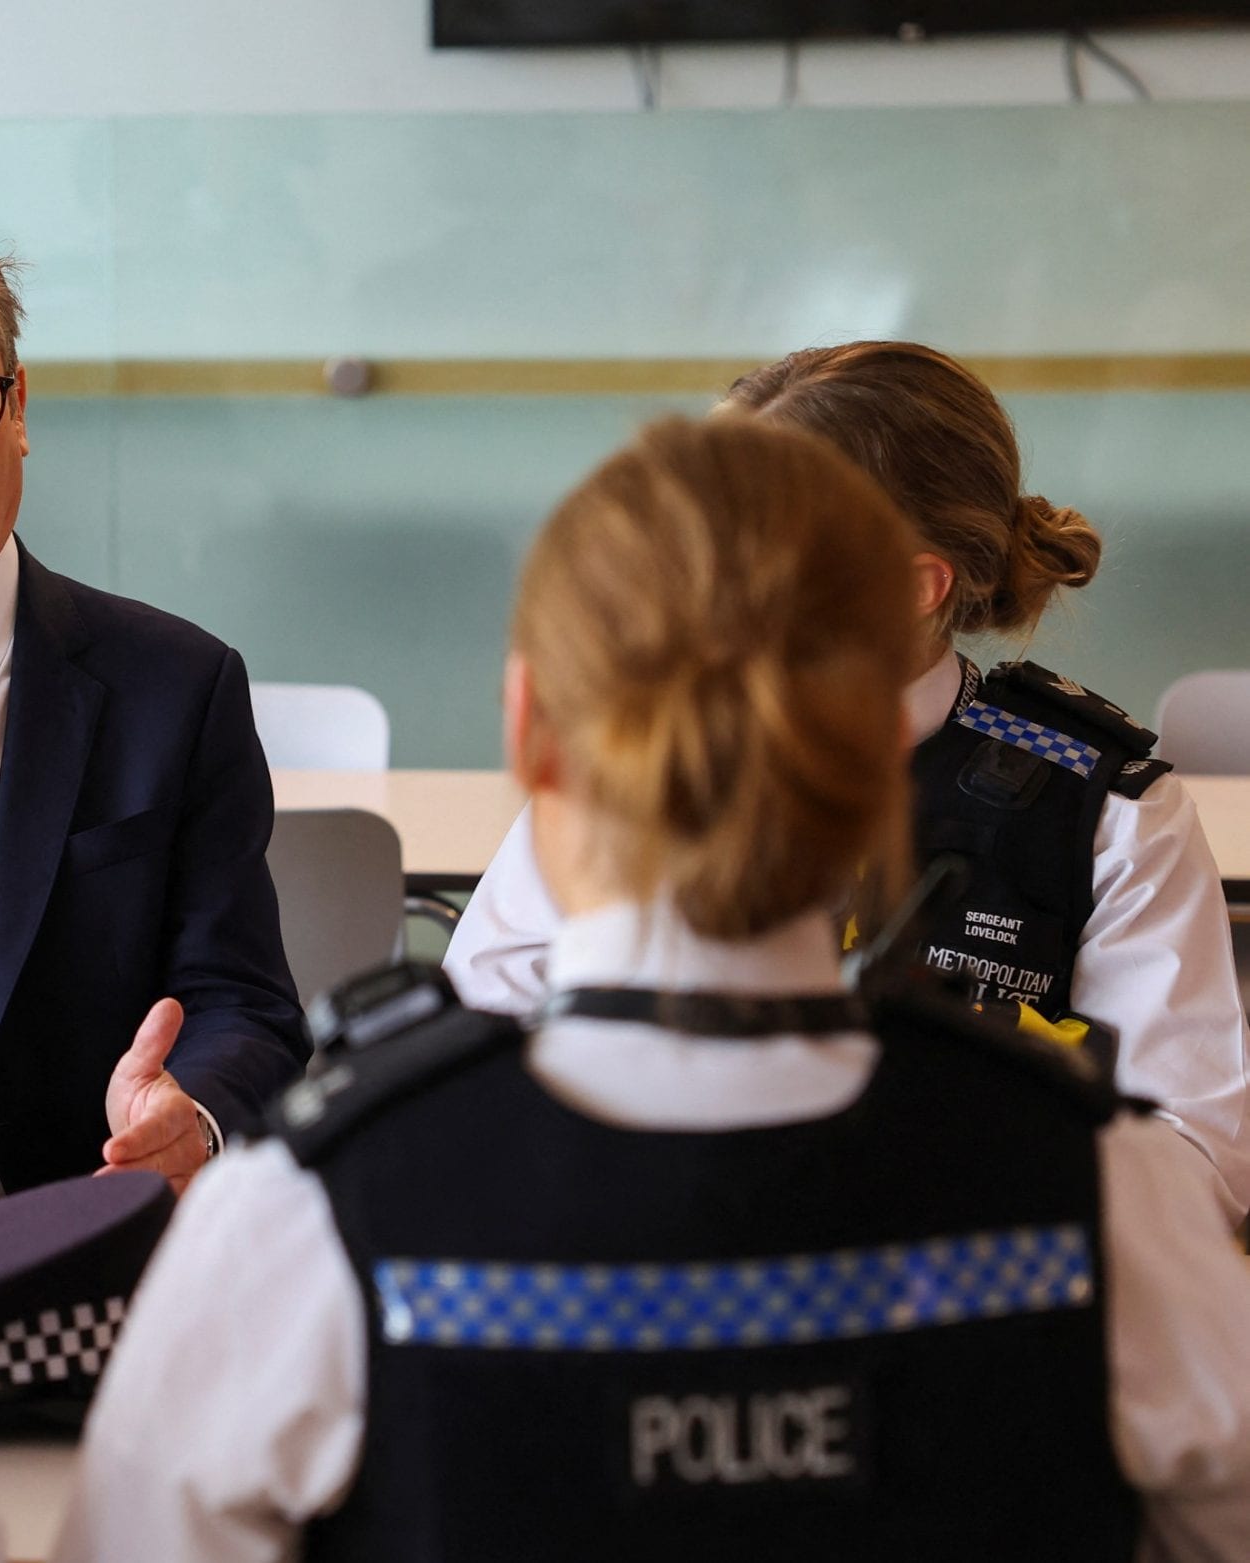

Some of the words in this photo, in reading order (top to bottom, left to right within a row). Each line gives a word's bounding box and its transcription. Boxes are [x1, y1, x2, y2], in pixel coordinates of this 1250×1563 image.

[964, 924, 1018, 945] LOVELOCK
[965, 910, 1024, 931] SERGEANT
[925, 945, 1054, 994] METROPOLITAN
[630, 1385, 856, 1486] POLICE
